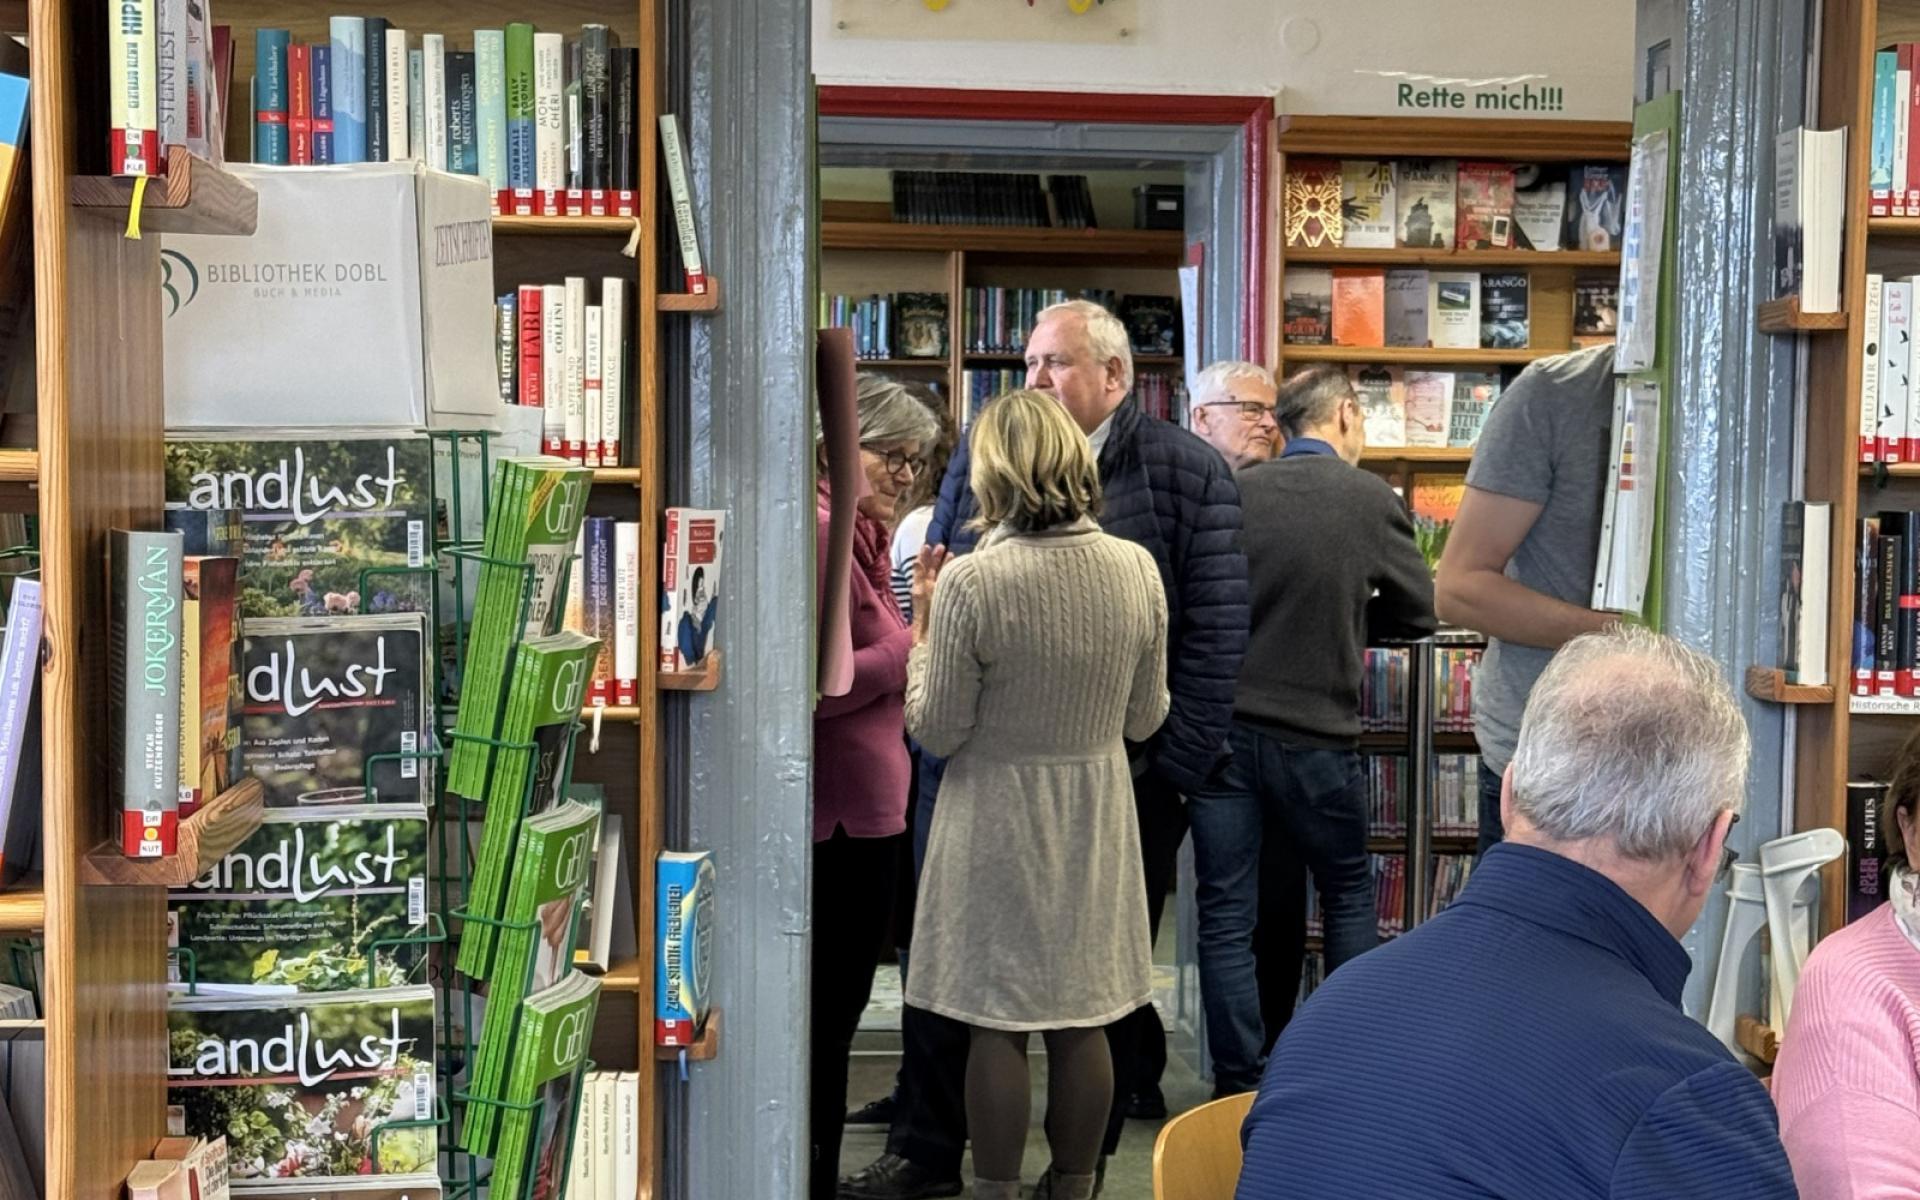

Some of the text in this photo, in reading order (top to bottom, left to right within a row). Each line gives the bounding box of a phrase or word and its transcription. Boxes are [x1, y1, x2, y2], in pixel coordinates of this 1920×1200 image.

[121, 0, 143, 35] HIP
[460, 73, 474, 145] sternenregen
[511, 78, 520, 109] SALLY
[538, 93, 561, 131] MON CHÉRI
[1397, 83, 1564, 112] Rette mich!!!
[450, 100, 462, 169] nora roberts
[511, 128, 521, 181] NORMALE
[207, 262, 388, 283] BIBLIOTHEK DOBL
[253, 287, 286, 298] BUCH
[304, 286, 343, 298] MEDIA
[555, 302, 563, 355] COLLINI
[501, 344, 512, 379] LETZTE
[589, 332, 598, 376] STRAFE
[501, 381, 512, 395] 25
[605, 355, 617, 437] NACHMITTAGE
[1864, 363, 1876, 433] NEUJAHR
[137, 545, 175, 697] JOKERMAN
[1851, 700, 1910, 711] Historische
[145, 733, 154, 769] STEFAN
[1863, 798, 1876, 850] SELFIES
